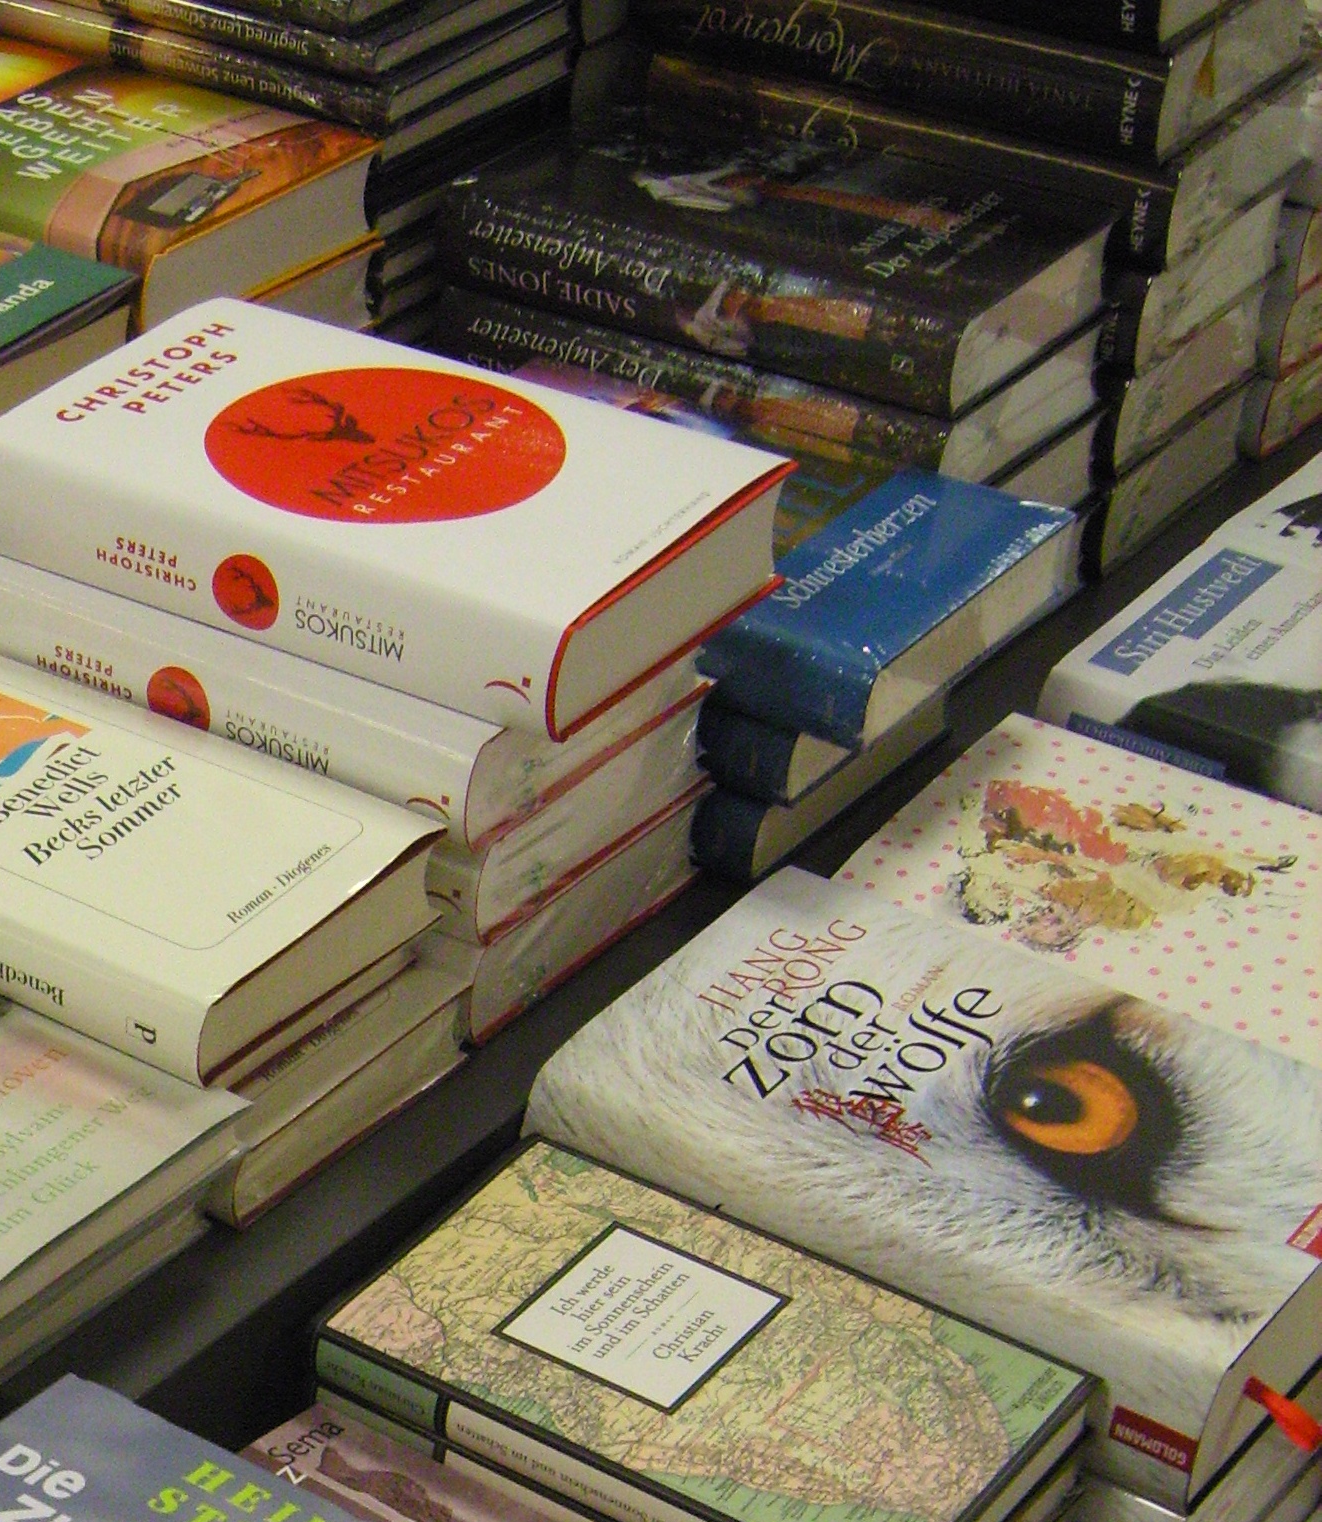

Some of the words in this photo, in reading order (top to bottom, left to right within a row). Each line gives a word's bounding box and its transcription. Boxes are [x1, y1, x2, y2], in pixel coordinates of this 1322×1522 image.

[1120, 91, 1140, 147] HEYNE
[468, 219, 616, 277] Außenseiter
[468, 256, 551, 296] JONES
[557, 278, 637, 319] SADIE
[618, 263, 670, 293] Der
[467, 316, 611, 371] Außenseiter
[55, 321, 238, 424] CHRISTOPH
[122, 350, 240, 416] PETERS
[309, 392, 499, 507] MITSUKOS
[352, 403, 519, 516] RESTAURANT
[95, 546, 198, 593] CHRISTOPH
[115, 536, 179, 570] PETERS
[771, 493, 938, 610] Schwesterherzen
[294, 609, 405, 664] MITSUKOS
[1114, 624, 1172, 668] Siri
[1153, 553, 1266, 632] Hustvedt
[35, 653, 135, 702] CHRISTOPH
[53, 644, 115, 678] PETERS
[224, 720, 330, 776] MITSUKOS
[21, 802, 104, 868] Becks
[97, 752, 179, 825] letzter
[25, 766, 111, 828] Wells
[74, 779, 184, 863] Sommer
[225, 886, 274, 927] Roman
[274, 841, 334, 891] Diogenes
[696, 925, 810, 1015] JIANG
[761, 917, 868, 1000] RONG
[827, 1013, 899, 1072] der
[28, 1157, 101, 1217] Glück
[549, 1289, 577, 1318] Ich
[572, 1262, 615, 1304] werde
[577, 1293, 607, 1323] hier
[602, 1273, 631, 1304] sein
[585, 1260, 674, 1339] Sonnenschein
[592, 1328, 623, 1360] und
[634, 1269, 690, 1322] Schatten
[652, 1307, 716, 1363] Christian
[679, 1321, 730, 1364] Kracht
[266, 1420, 346, 1467] Sema
[1115, 1423, 1188, 1466] GOLDMANN
